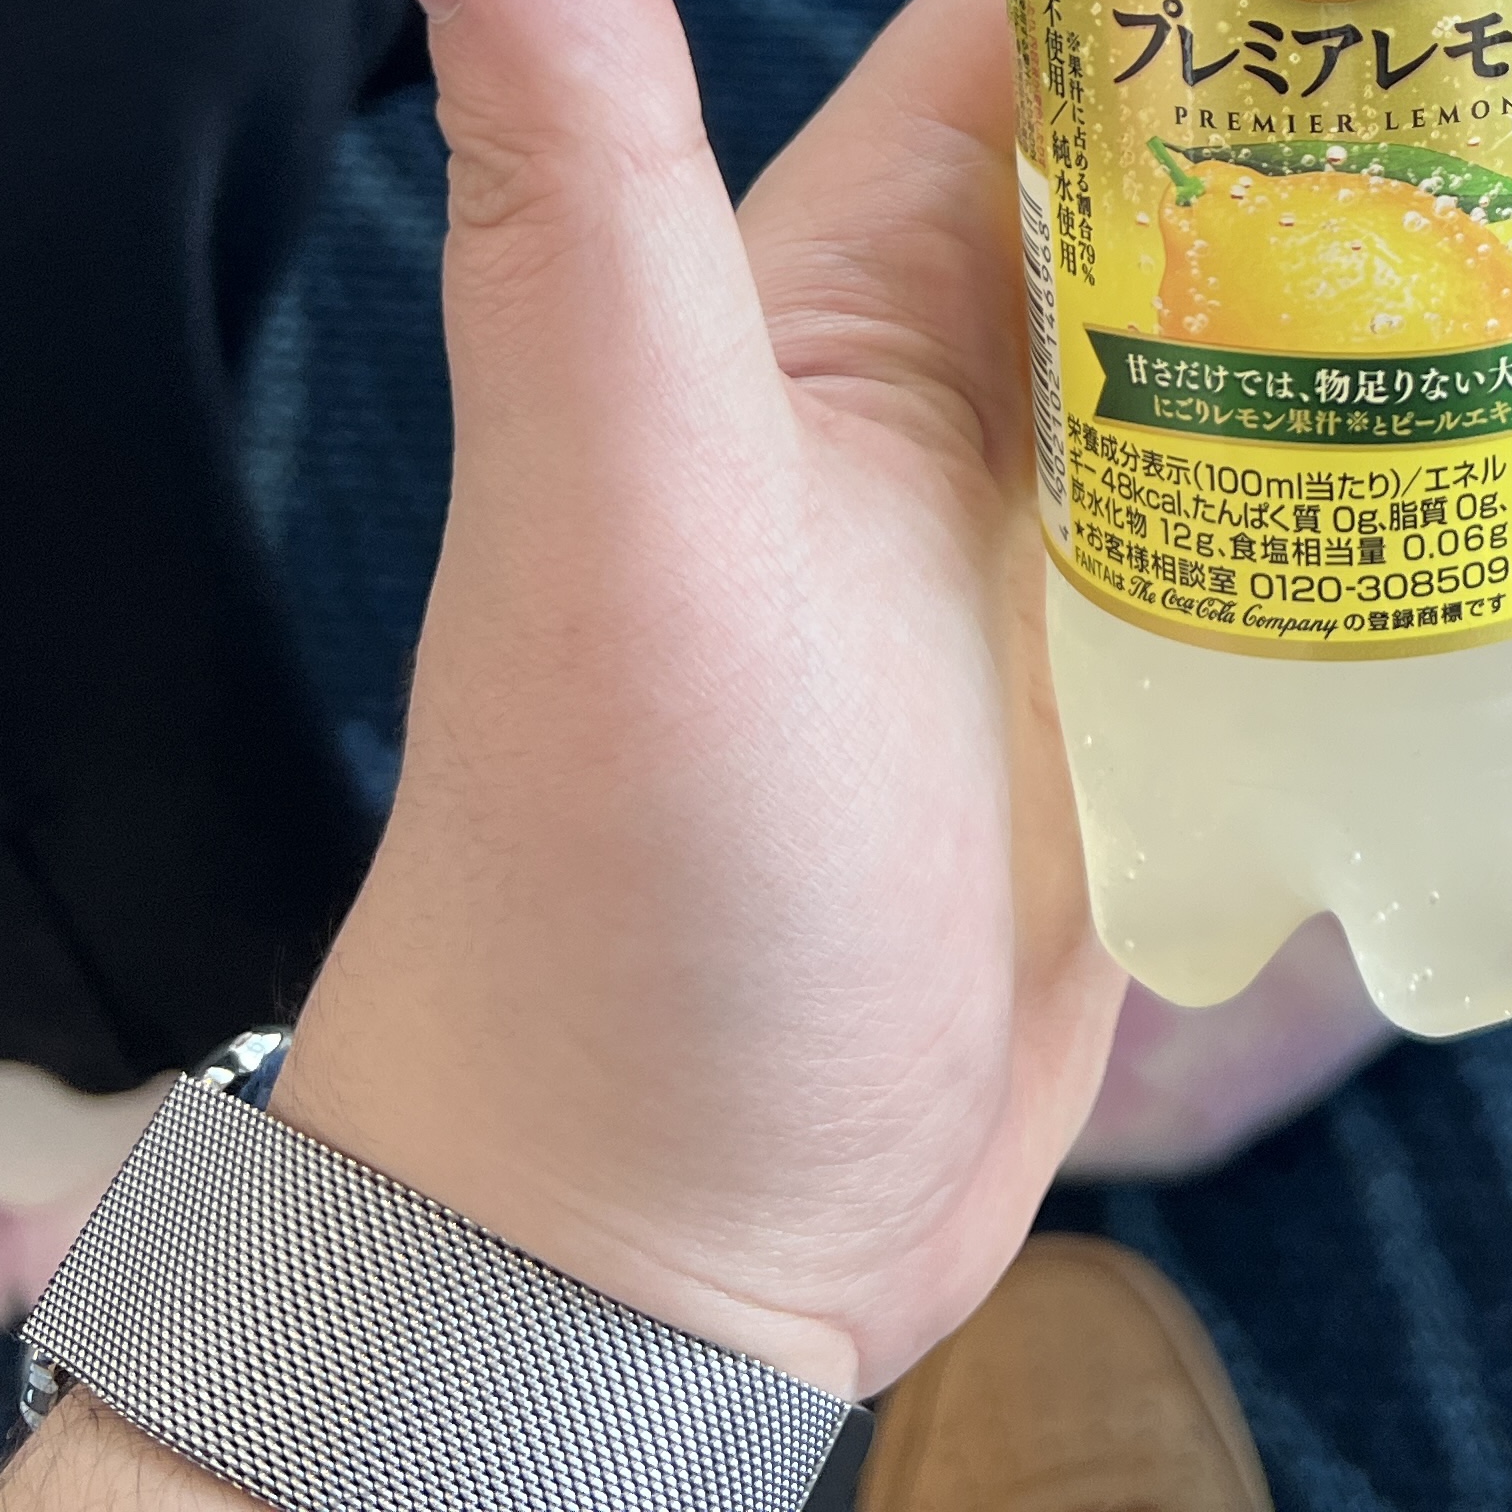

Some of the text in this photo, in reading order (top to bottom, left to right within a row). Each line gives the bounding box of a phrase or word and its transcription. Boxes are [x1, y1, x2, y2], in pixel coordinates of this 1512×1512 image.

[1174, 105, 1356, 134] PREMIER
[1402, 521, 1509, 562] 0.06g
[1249, 554, 1510, 604] 0120-308509
[1241, 603, 1340, 641] Company
